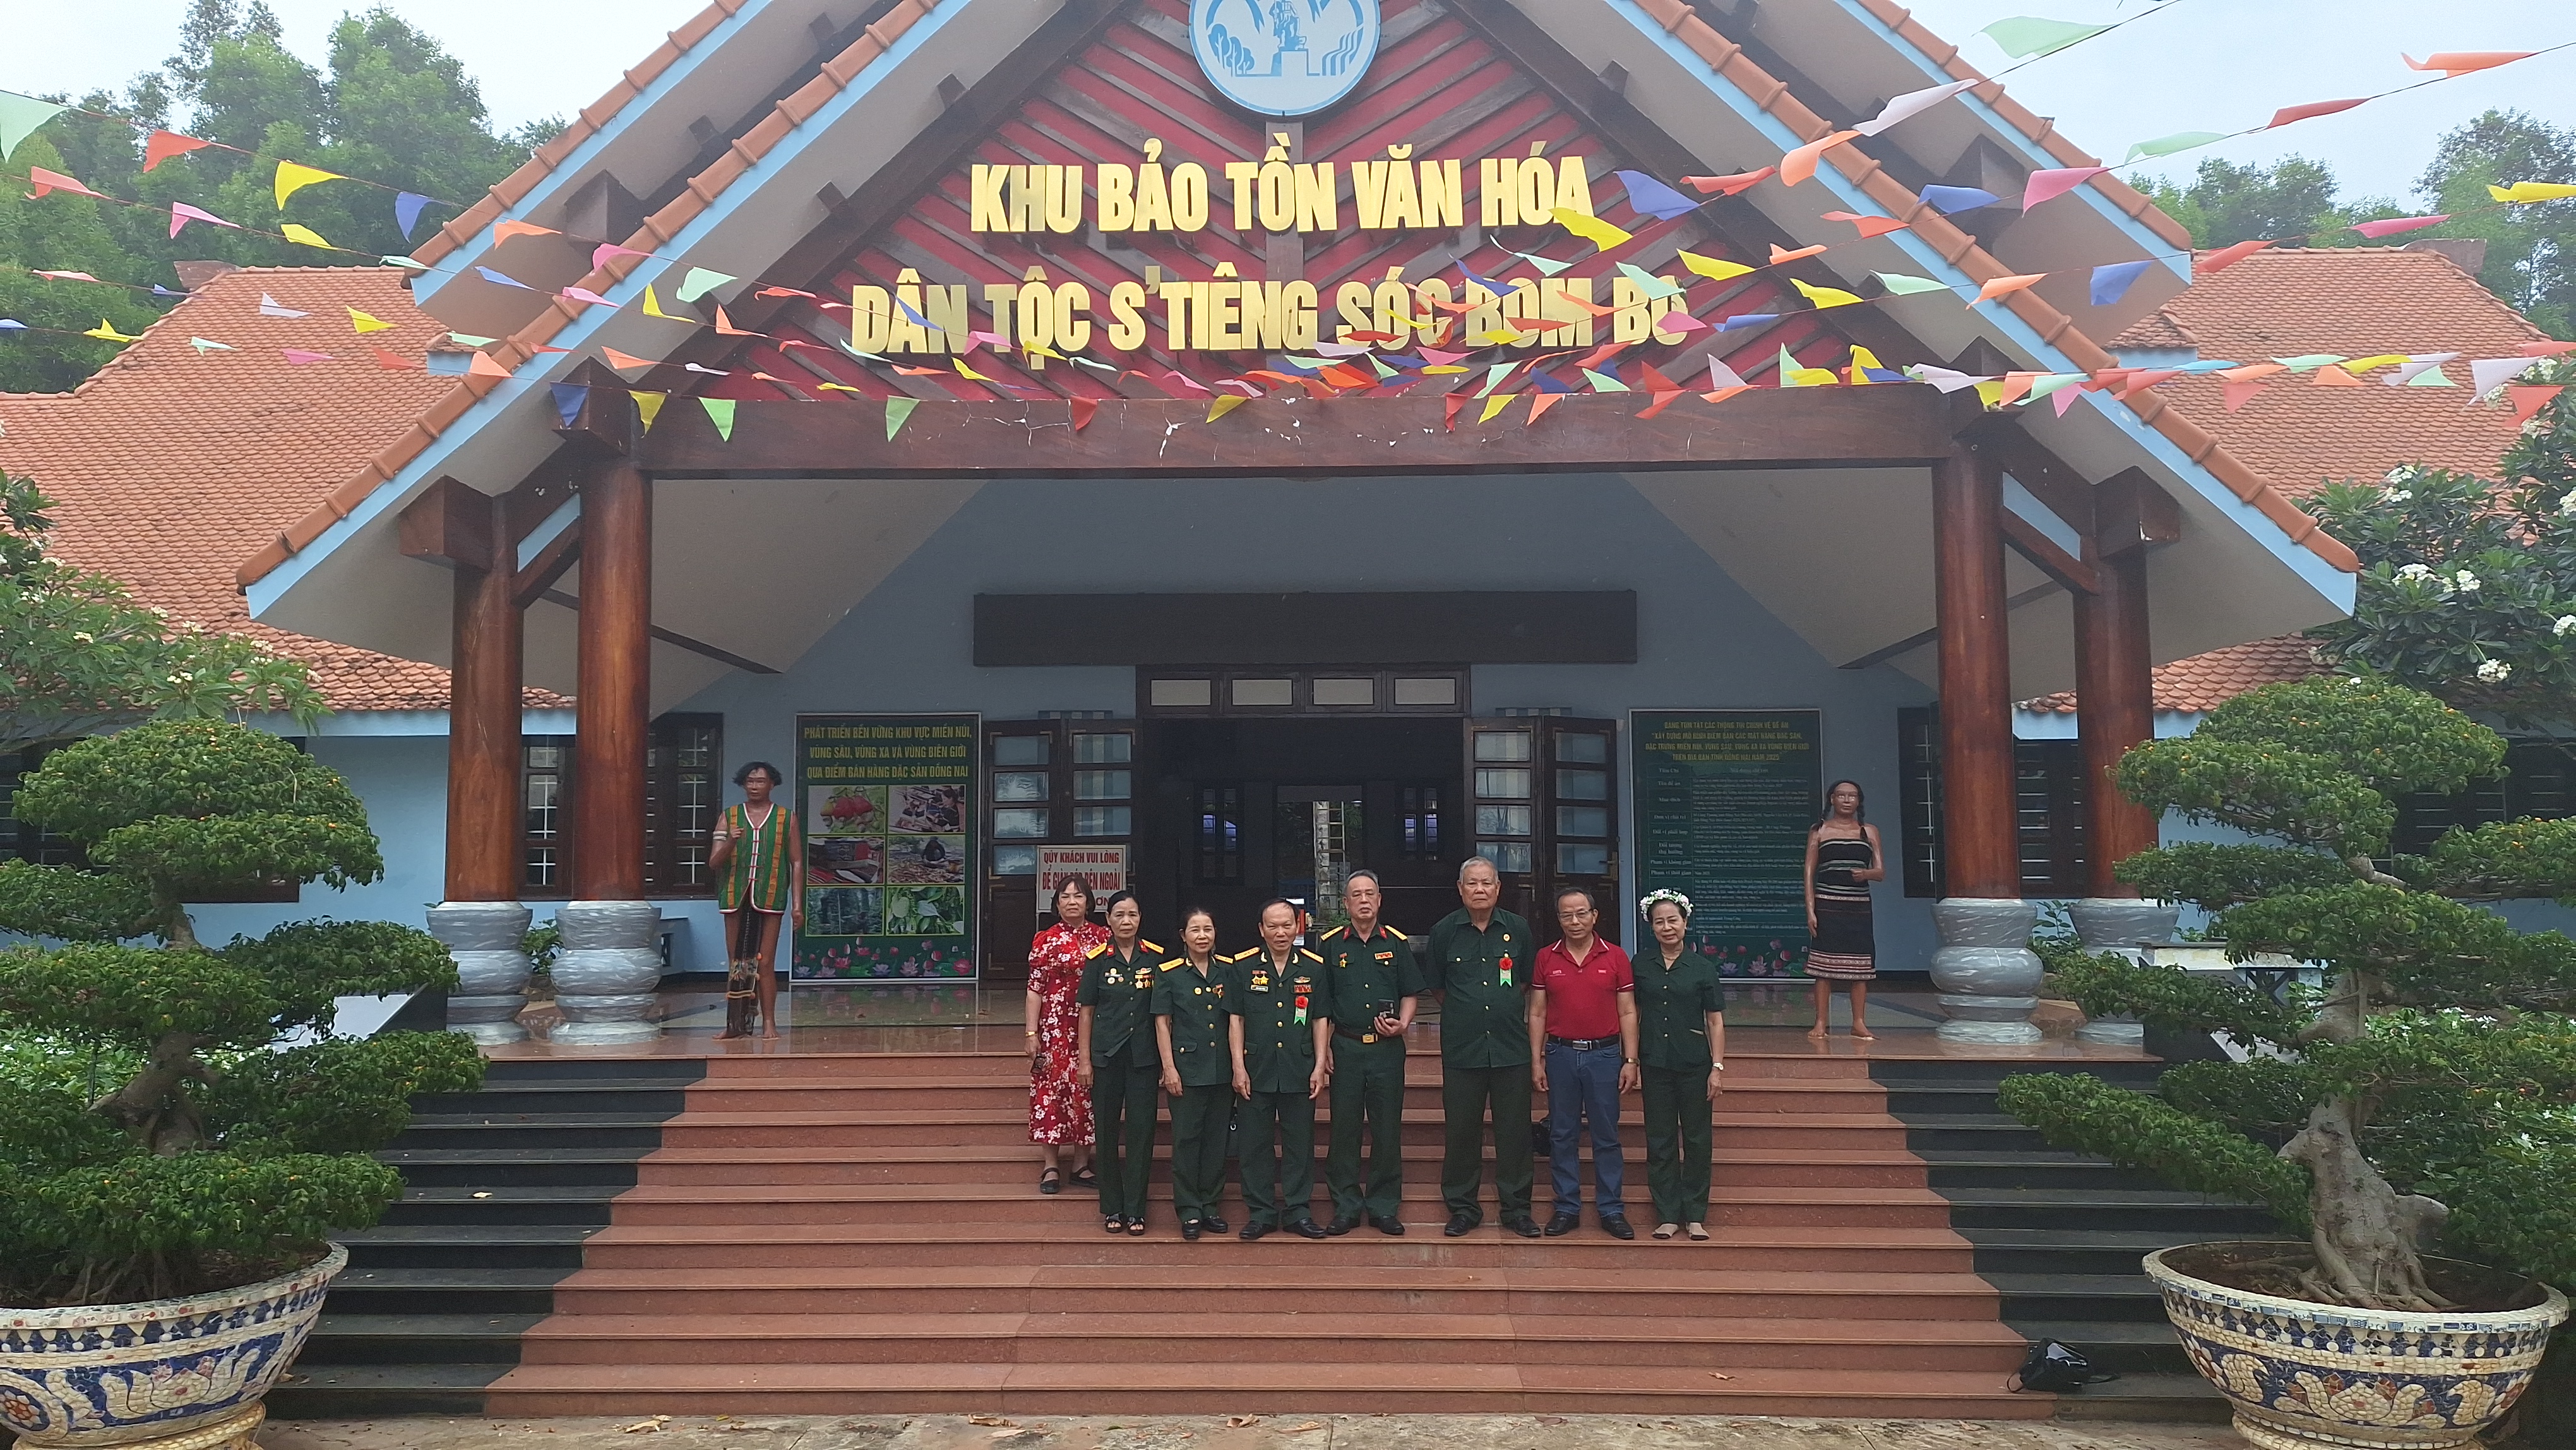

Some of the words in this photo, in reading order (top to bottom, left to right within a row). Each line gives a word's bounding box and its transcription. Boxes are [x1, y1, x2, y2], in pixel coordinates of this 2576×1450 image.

[971, 164, 1083, 234] KHU
[1097, 138, 1208, 232] BẢO
[1225, 133, 1338, 232] TỒN
[1351, 144, 1464, 229] VĂN
[1481, 140, 1595, 227] HÓA
[852, 267, 969, 354] DÂN
[984, 265, 1090, 371] TỘC
[1335, 265, 1453, 351] SÓC
[1465, 277, 1594, 348] BOM
[1613, 275, 1688, 346] BO
[804, 724, 825, 738] PHÁT
[827, 722, 851, 738] TRIỂN
[895, 726, 912, 738] KHU
[914, 726, 930, 741] VỰC
[855, 744, 877, 758] VÙNG
[879, 746, 890, 758] XA
[905, 744, 926, 758] VÙNG
[928, 743, 948, 758] BIÊN
[950, 743, 966, 757] GIỚI
[807, 766, 823, 779] QUA
[825, 762, 847, 778] ĐIỂM
[847, 764, 865, 777] BÁN
[867, 764, 890, 777] HÀNG
[891, 764, 908, 781] ĐẶC
[954, 765, 969, 777] NAI
[1059, 850, 1085, 863] KHÁCH
[1086, 852, 1098, 863] VUI
[1100, 849, 1119, 863] LÒNG
[1042, 864, 1051, 890] ĐỂ
[1099, 868, 1121, 891] NGOÀI
